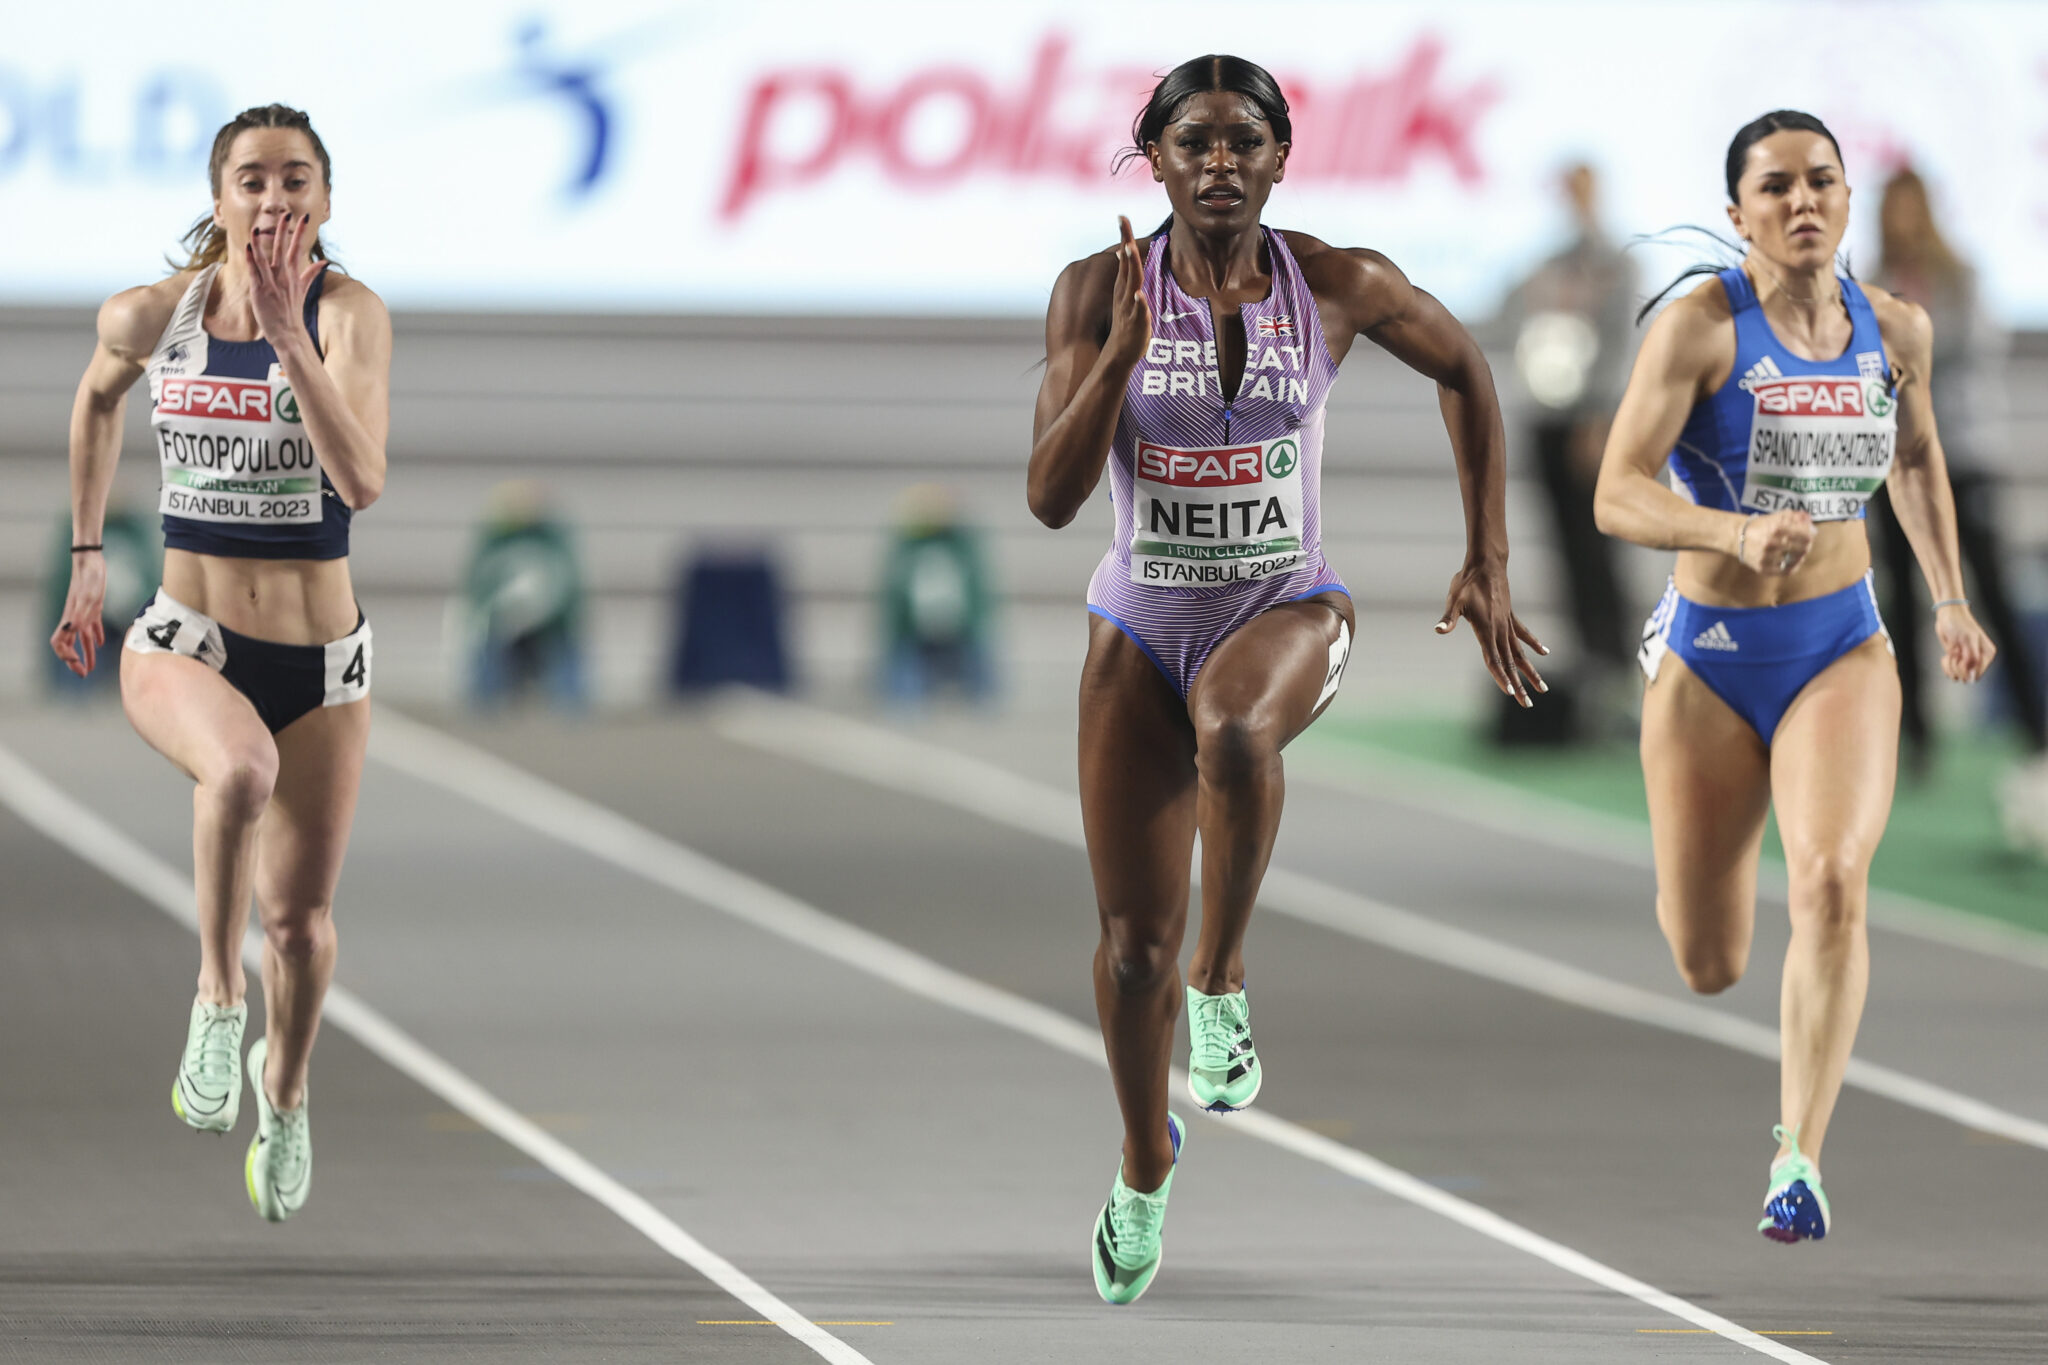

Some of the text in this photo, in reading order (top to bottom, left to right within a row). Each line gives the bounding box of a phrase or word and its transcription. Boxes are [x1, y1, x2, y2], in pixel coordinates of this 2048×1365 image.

[1145, 337, 1305, 372] GREAT
[161, 383, 268, 417] SPAR
[1142, 369, 1308, 405] BRITAIN
[1759, 383, 1863, 413] SPAR
[159, 428, 313, 473] FOTOPOULOU
[1141, 448, 1260, 482] SPAR
[168, 491, 310, 519] ISTANBUL 2023
[1150, 496, 1288, 539] NEITA
[1143, 554, 1298, 582] ISTANBUL 2023
[1176, 545, 1211, 558] RUN
[146, 618, 182, 650] 4
[342, 643, 366, 688] 4
